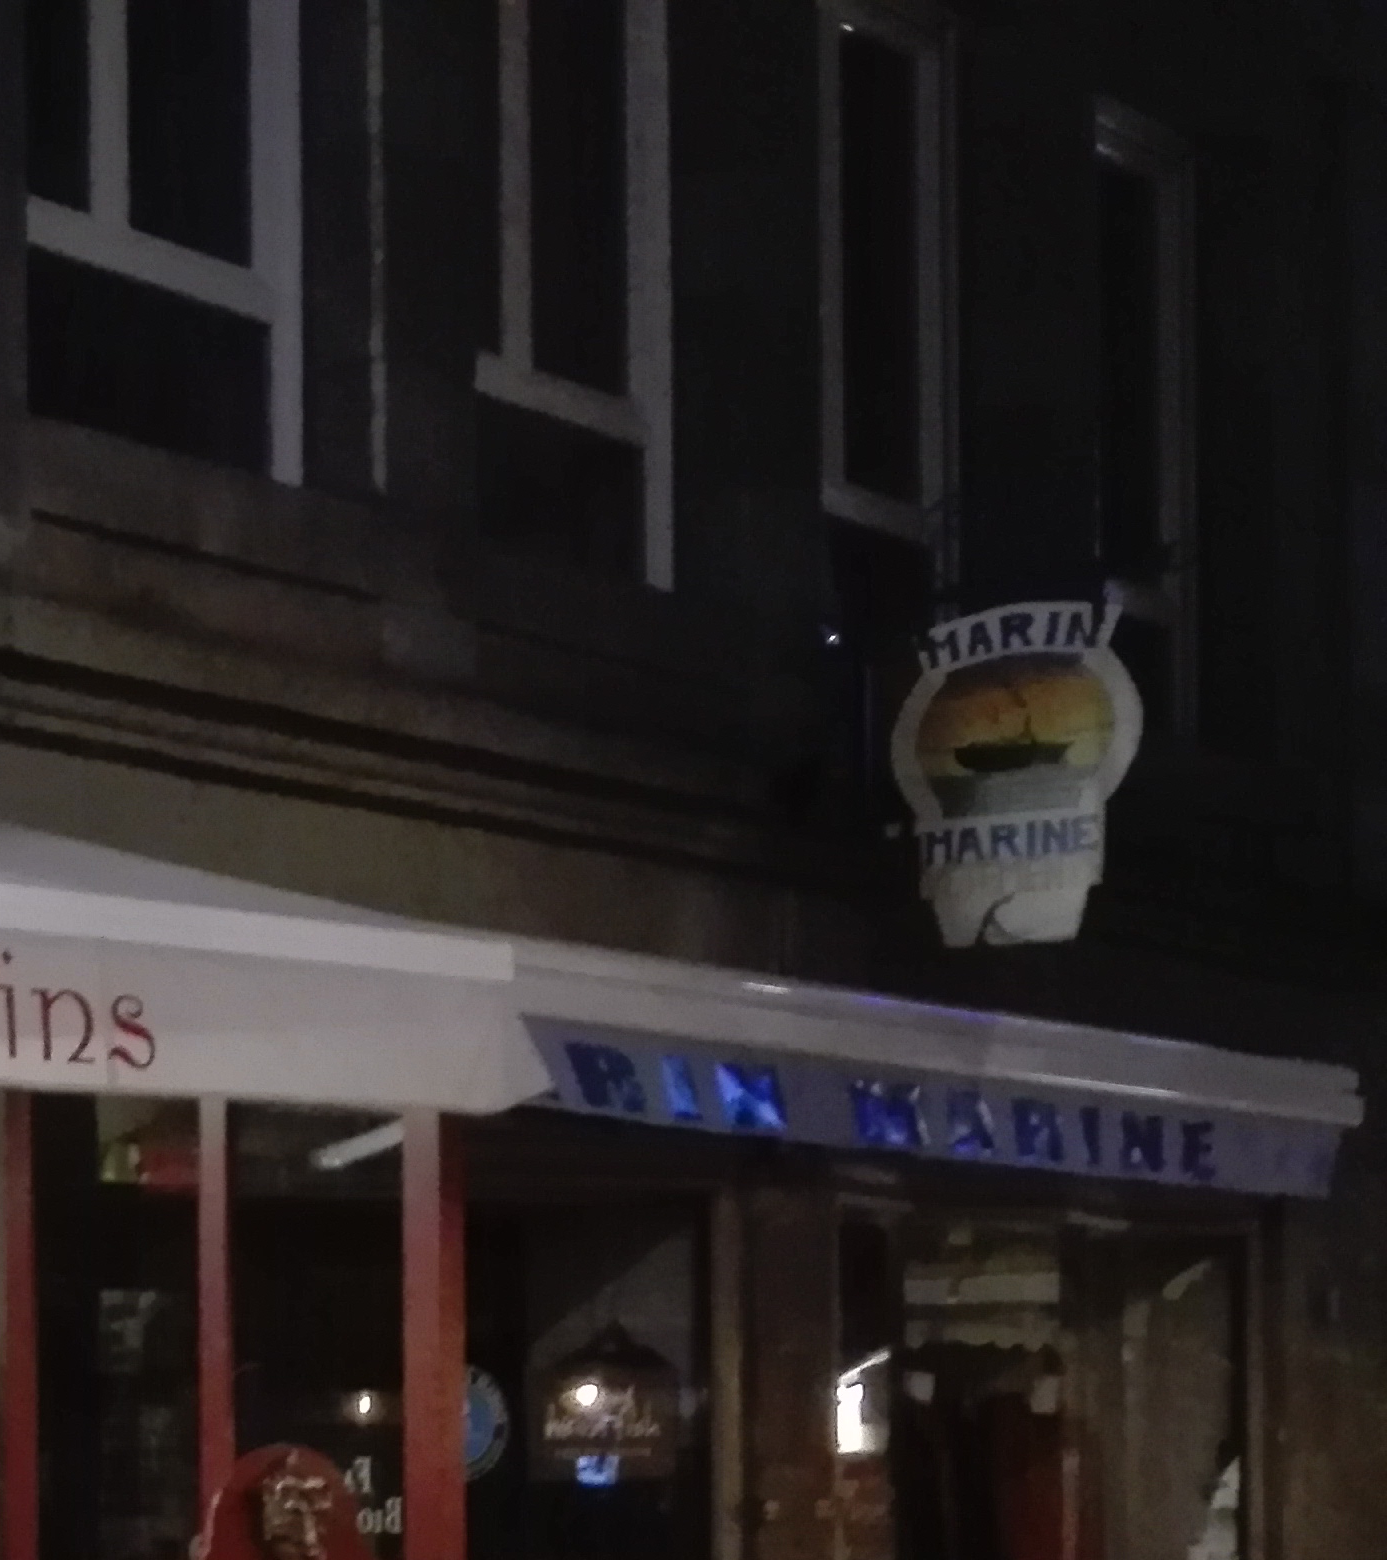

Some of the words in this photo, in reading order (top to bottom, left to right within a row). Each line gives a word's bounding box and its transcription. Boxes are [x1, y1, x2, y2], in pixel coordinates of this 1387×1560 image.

[919, 606, 1101, 668] MARIN
[923, 814, 1097, 867] MARINE
[547, 1040, 788, 1132] RIN
